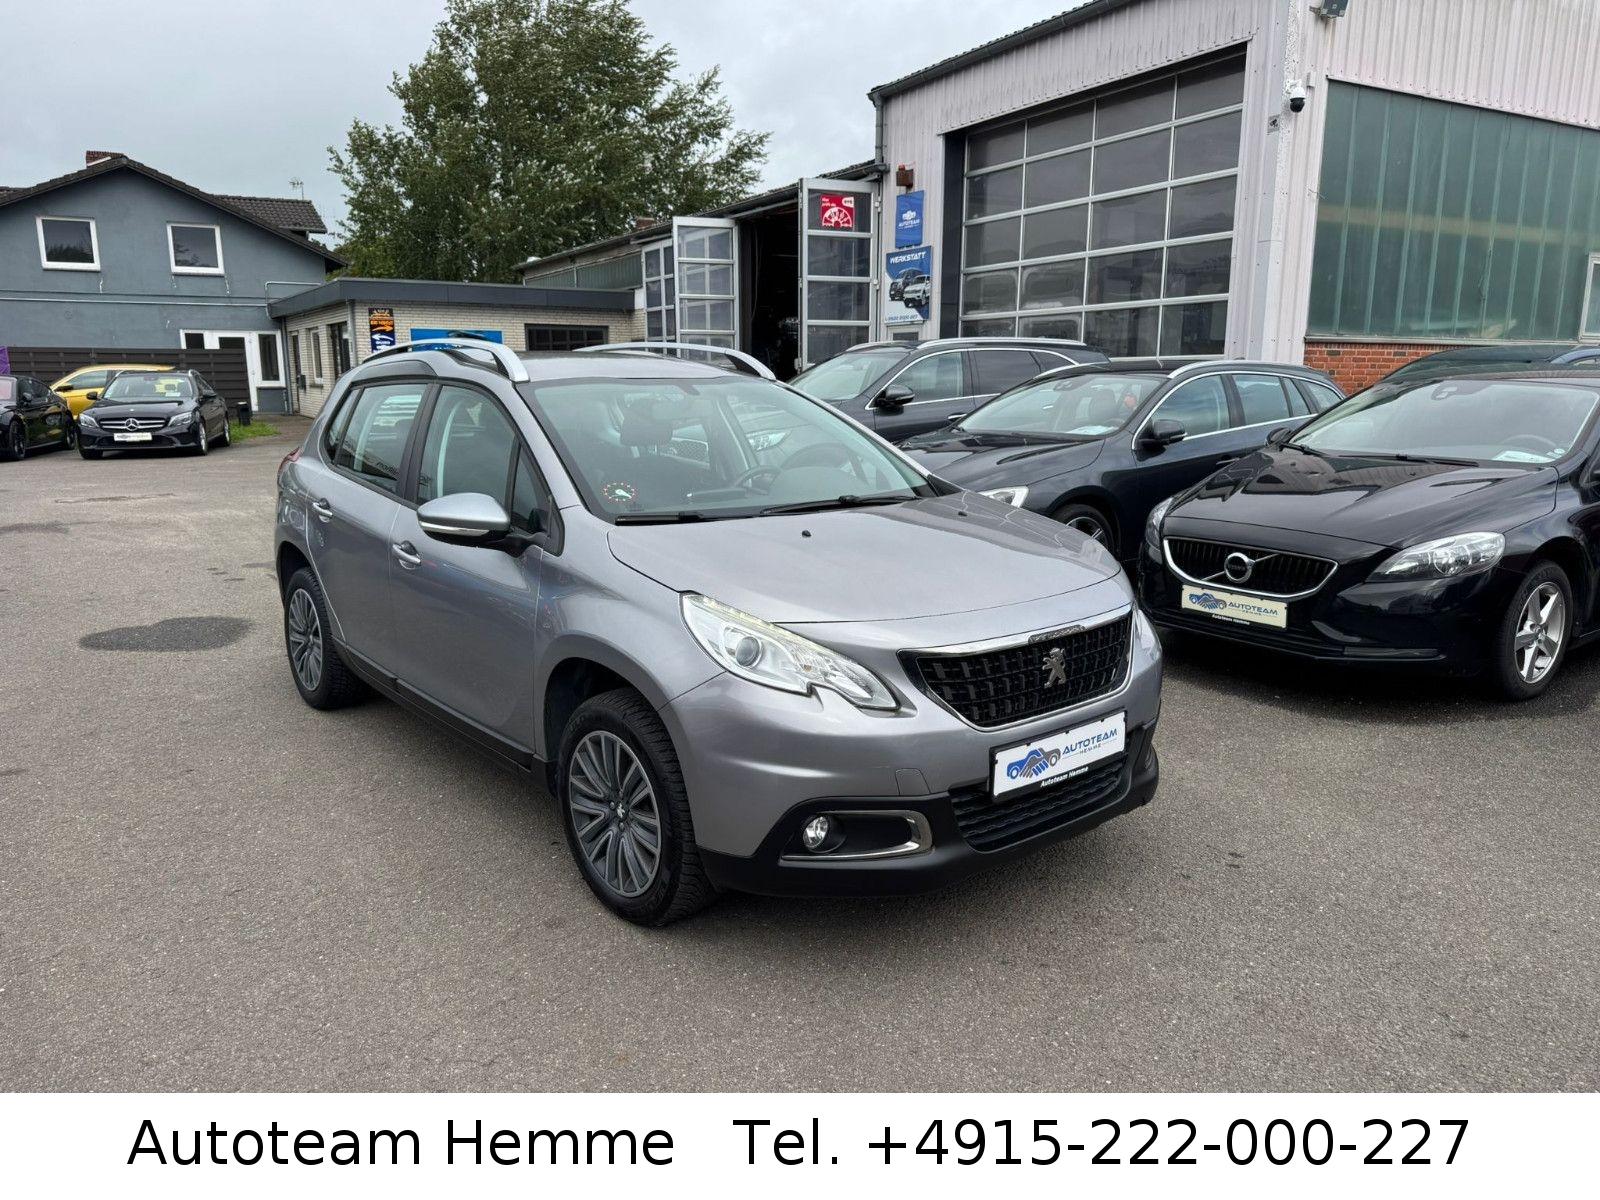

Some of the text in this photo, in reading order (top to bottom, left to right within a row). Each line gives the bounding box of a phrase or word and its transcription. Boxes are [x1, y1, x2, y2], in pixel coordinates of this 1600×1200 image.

[889, 251, 926, 264] WERKSTATT
[1228, 602, 1278, 615] AUTOTEAM
[1062, 728, 1117, 755] AUTOTEAM
[1080, 743, 1101, 754] HEMME
[1040, 766, 1089, 787] Autoteam Hemme
